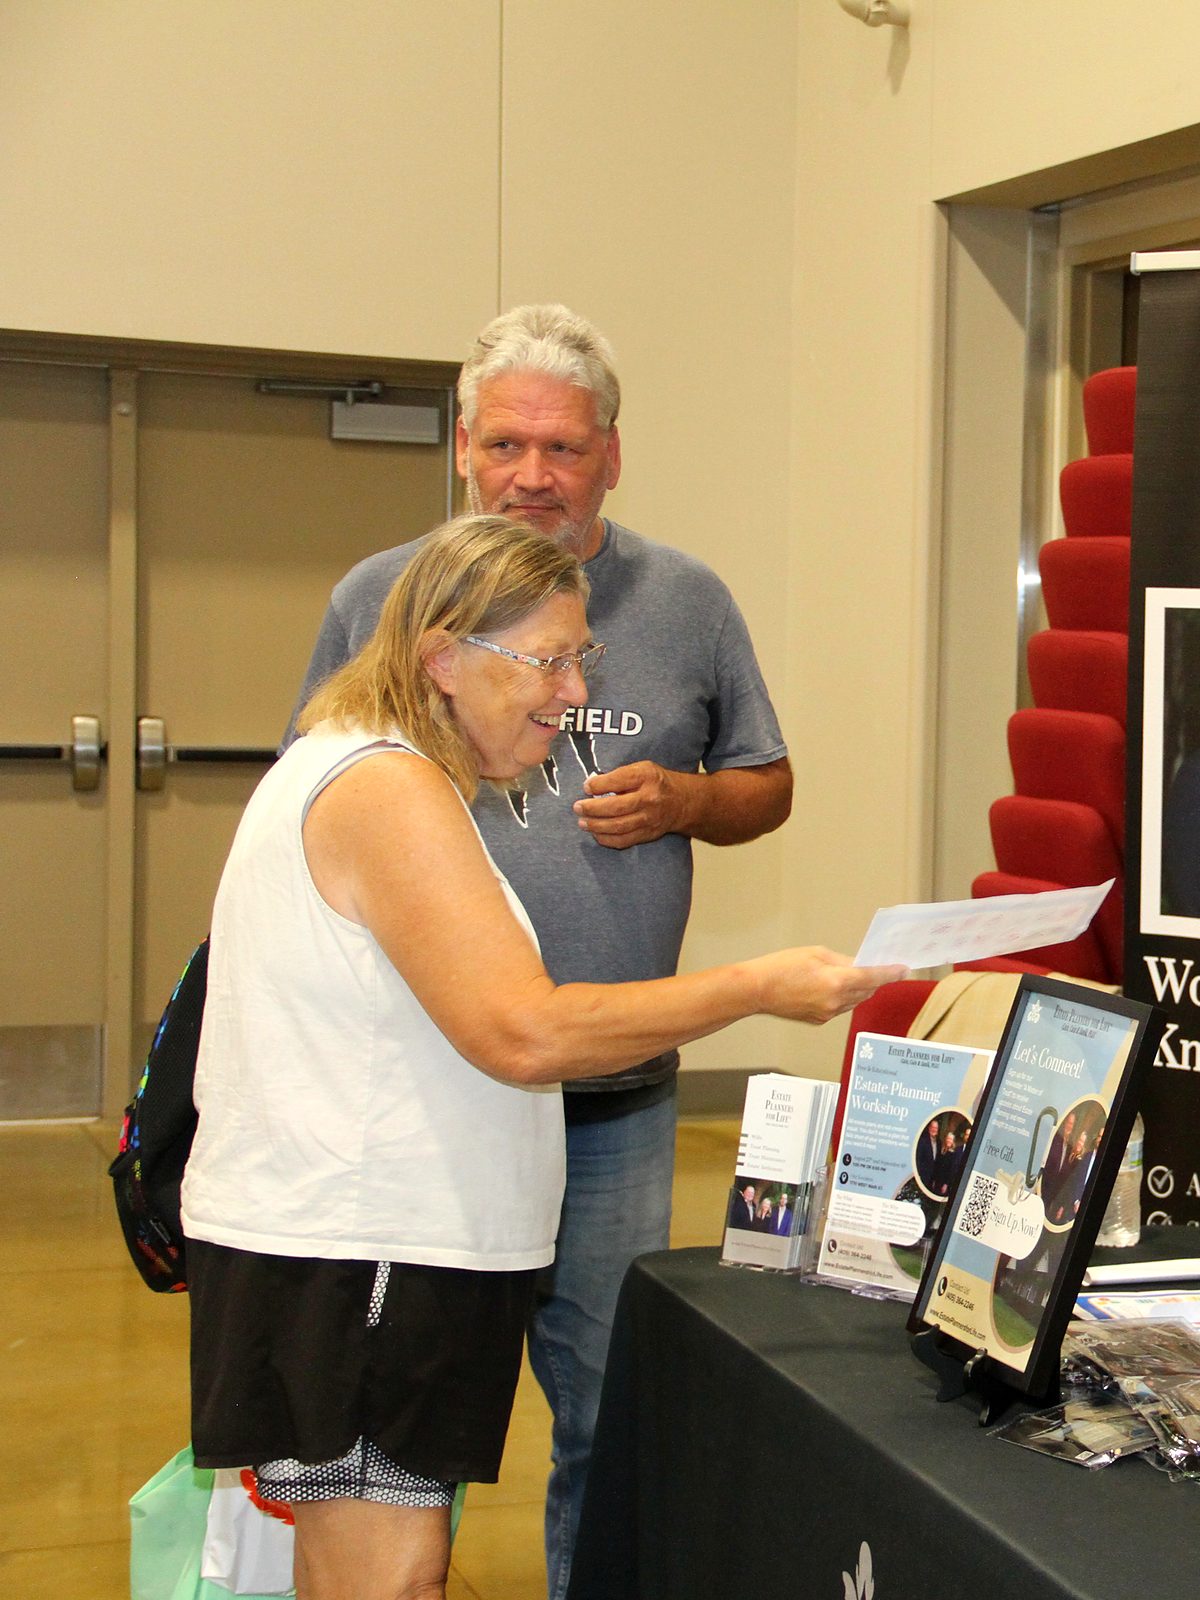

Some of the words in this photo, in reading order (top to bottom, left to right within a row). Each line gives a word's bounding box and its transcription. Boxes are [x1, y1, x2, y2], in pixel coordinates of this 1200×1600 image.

[558, 706, 643, 737] FIELD
[1013, 1040, 1039, 1065] Let's
[1038, 1047, 1085, 1079] Connect!
[771, 1089, 792, 1102] ESTATE
[854, 1075, 888, 1093] Estate
[890, 1081, 942, 1105] Planning
[851, 1094, 909, 1120] Workshop
[983, 1138, 1000, 1156] Free
[1000, 1145, 1015, 1163] Gift
[991, 1206, 1007, 1227] Sign
[1006, 1212, 1018, 1233] Up
[1018, 1217, 1039, 1238] Now!
